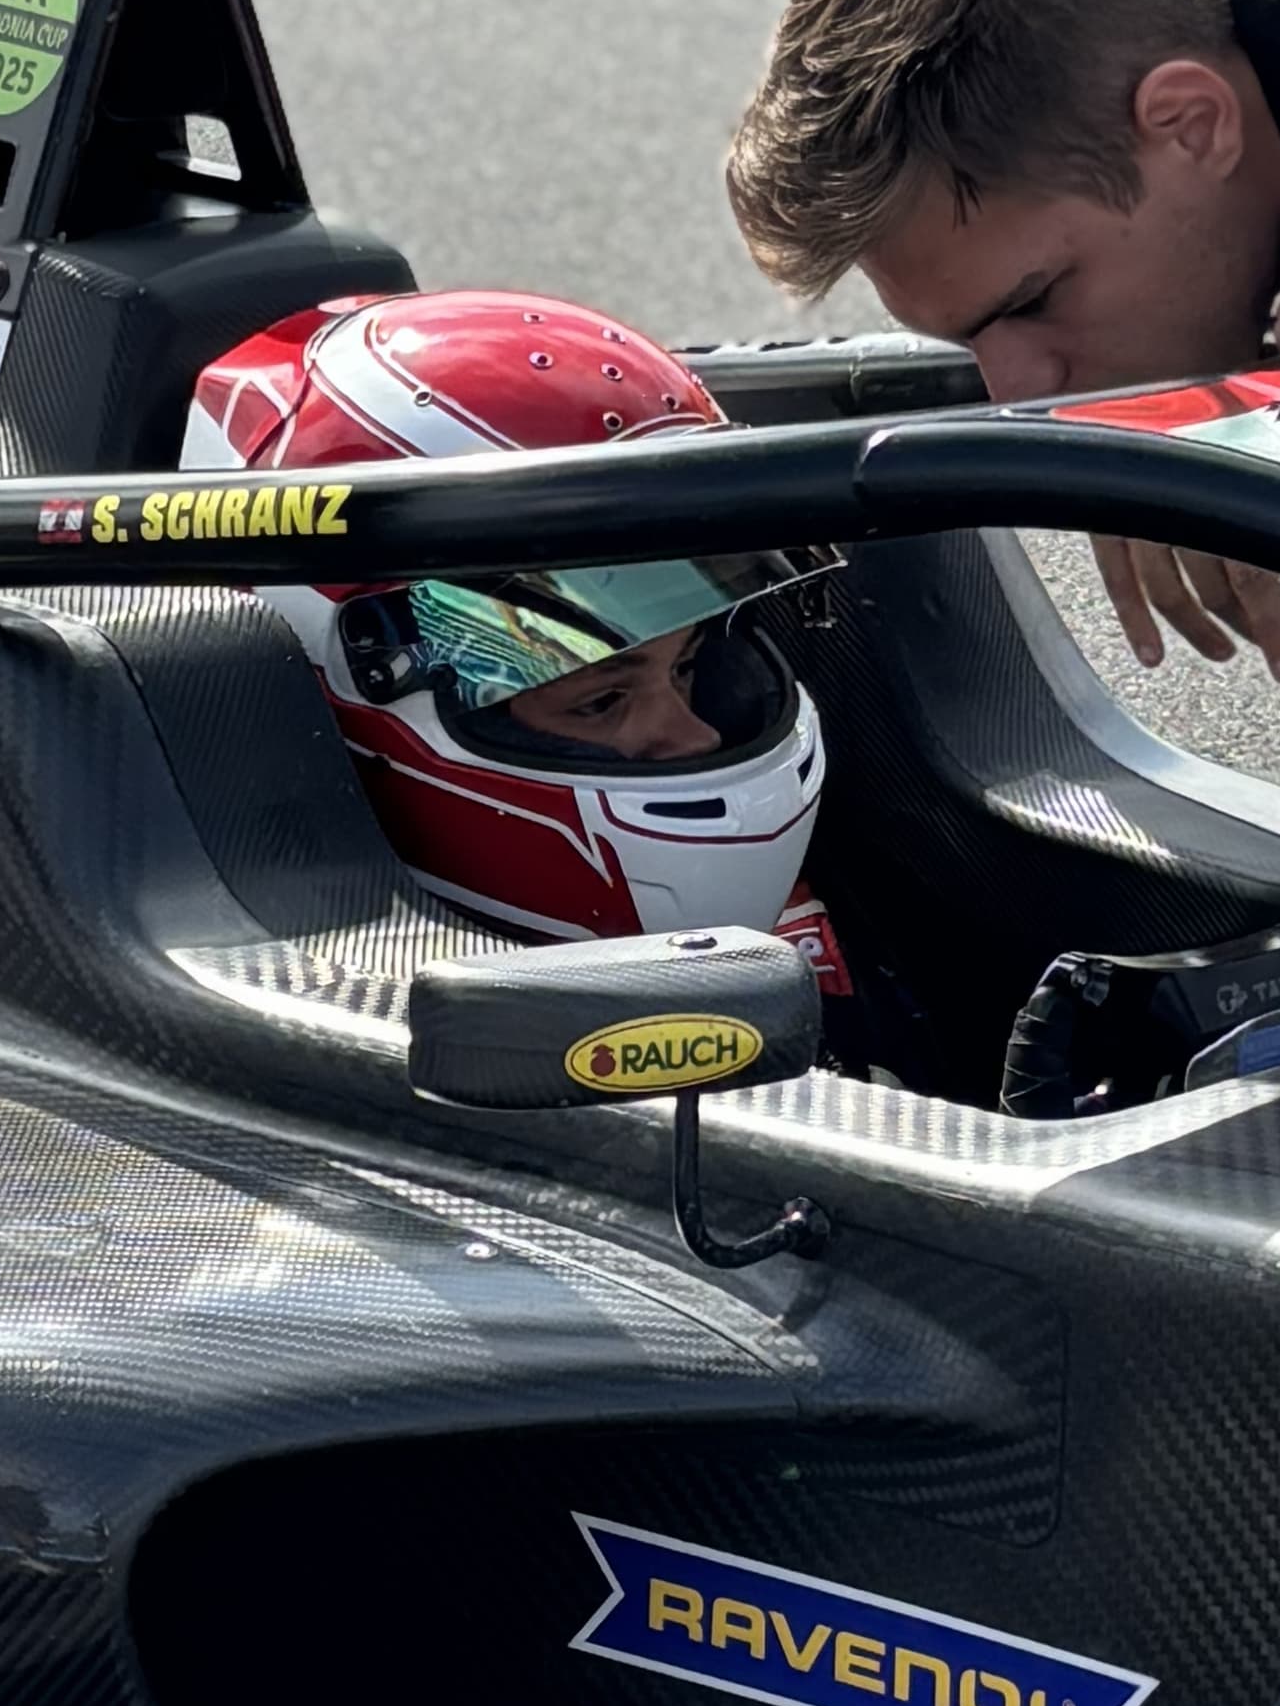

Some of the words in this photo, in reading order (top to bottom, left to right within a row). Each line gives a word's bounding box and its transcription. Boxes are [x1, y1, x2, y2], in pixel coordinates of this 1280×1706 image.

[36, 22, 70, 50] CUP
[91, 495, 128, 543] S.
[140, 484, 353, 541] SCHRANZ
[621, 1031, 738, 1075] RAUCH
